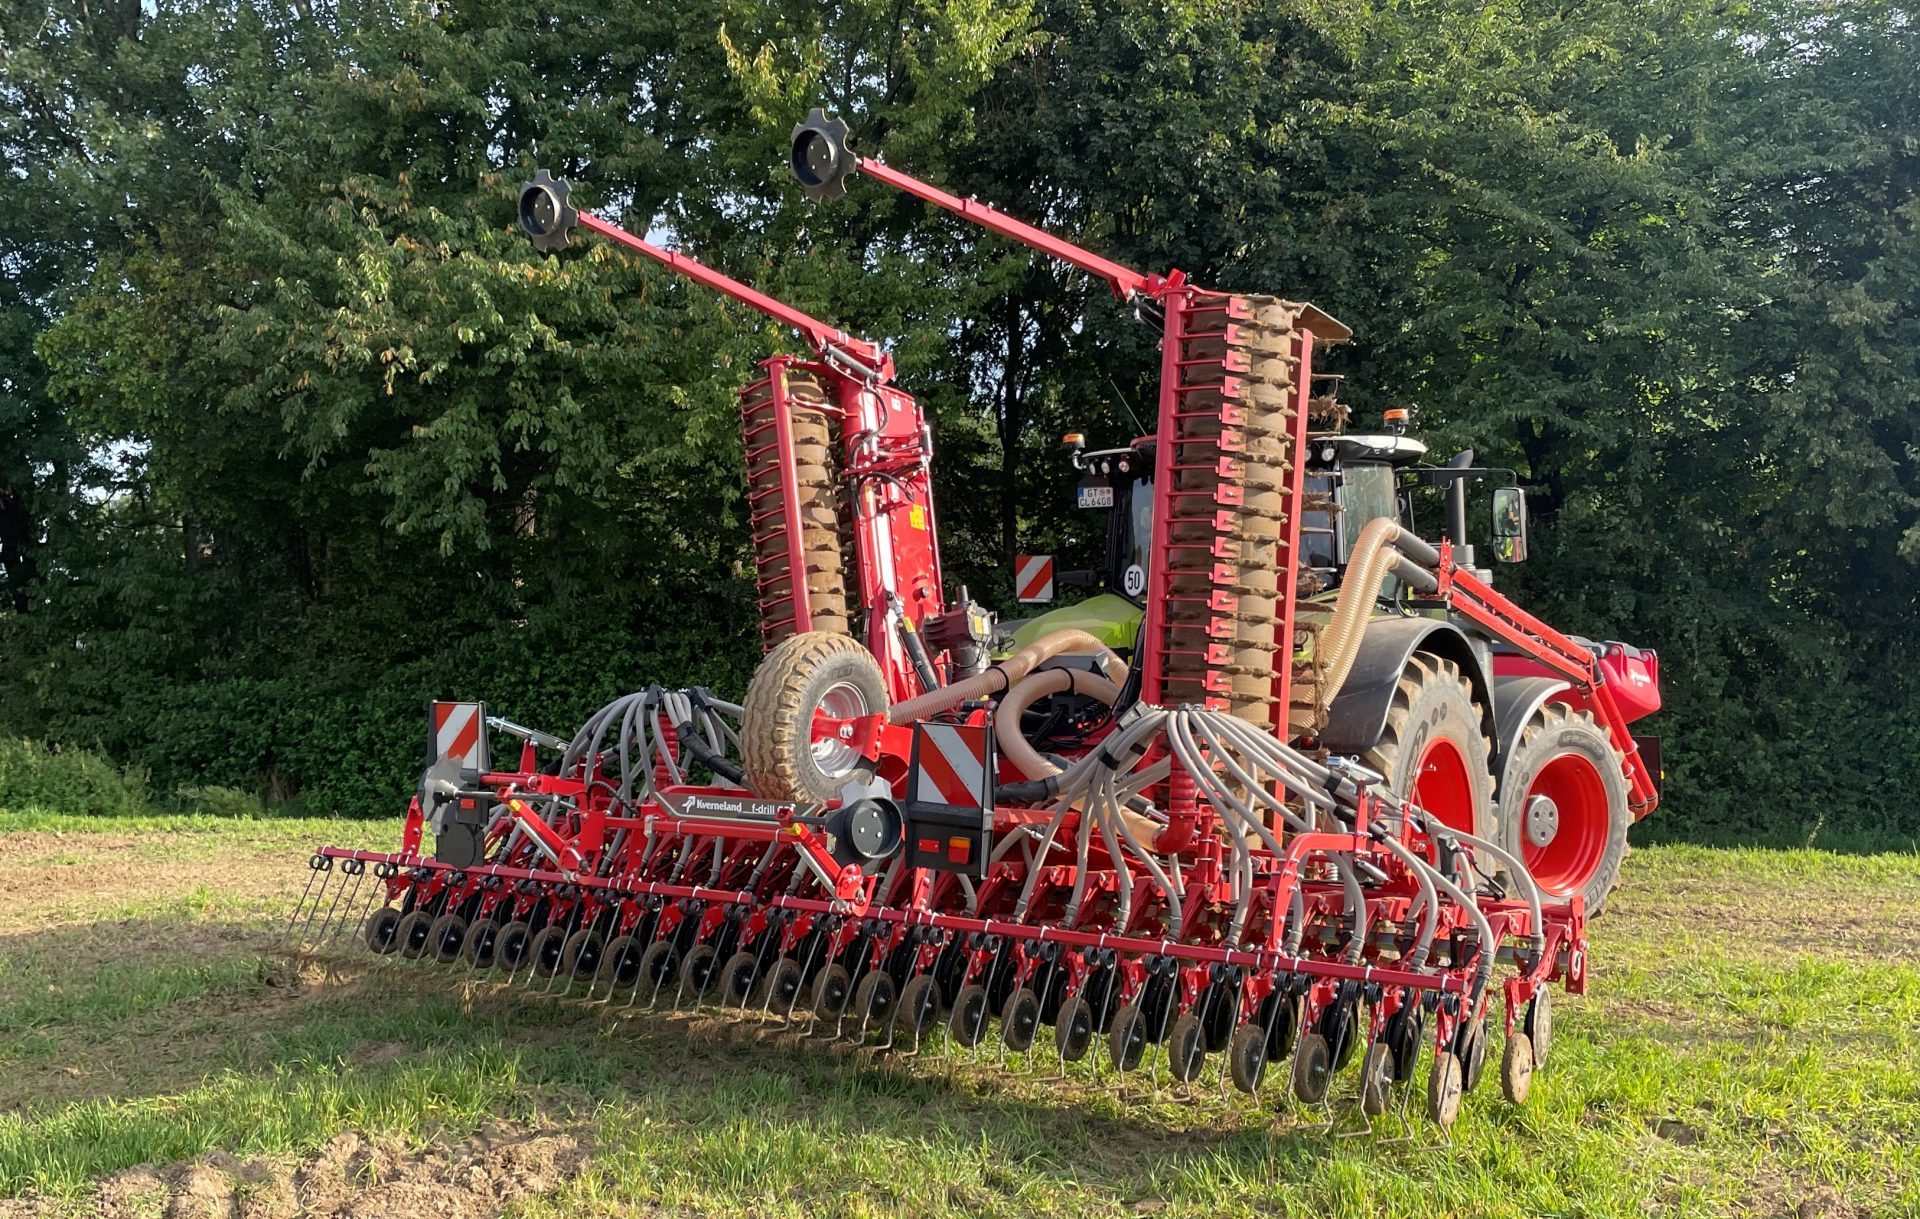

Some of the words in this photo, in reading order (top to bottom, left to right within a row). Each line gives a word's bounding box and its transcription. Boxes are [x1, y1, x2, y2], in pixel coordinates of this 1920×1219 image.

[1087, 489, 1098, 497] GT
[1127, 571, 1140, 590] 50
[696, 799, 742, 813] Kverneland
